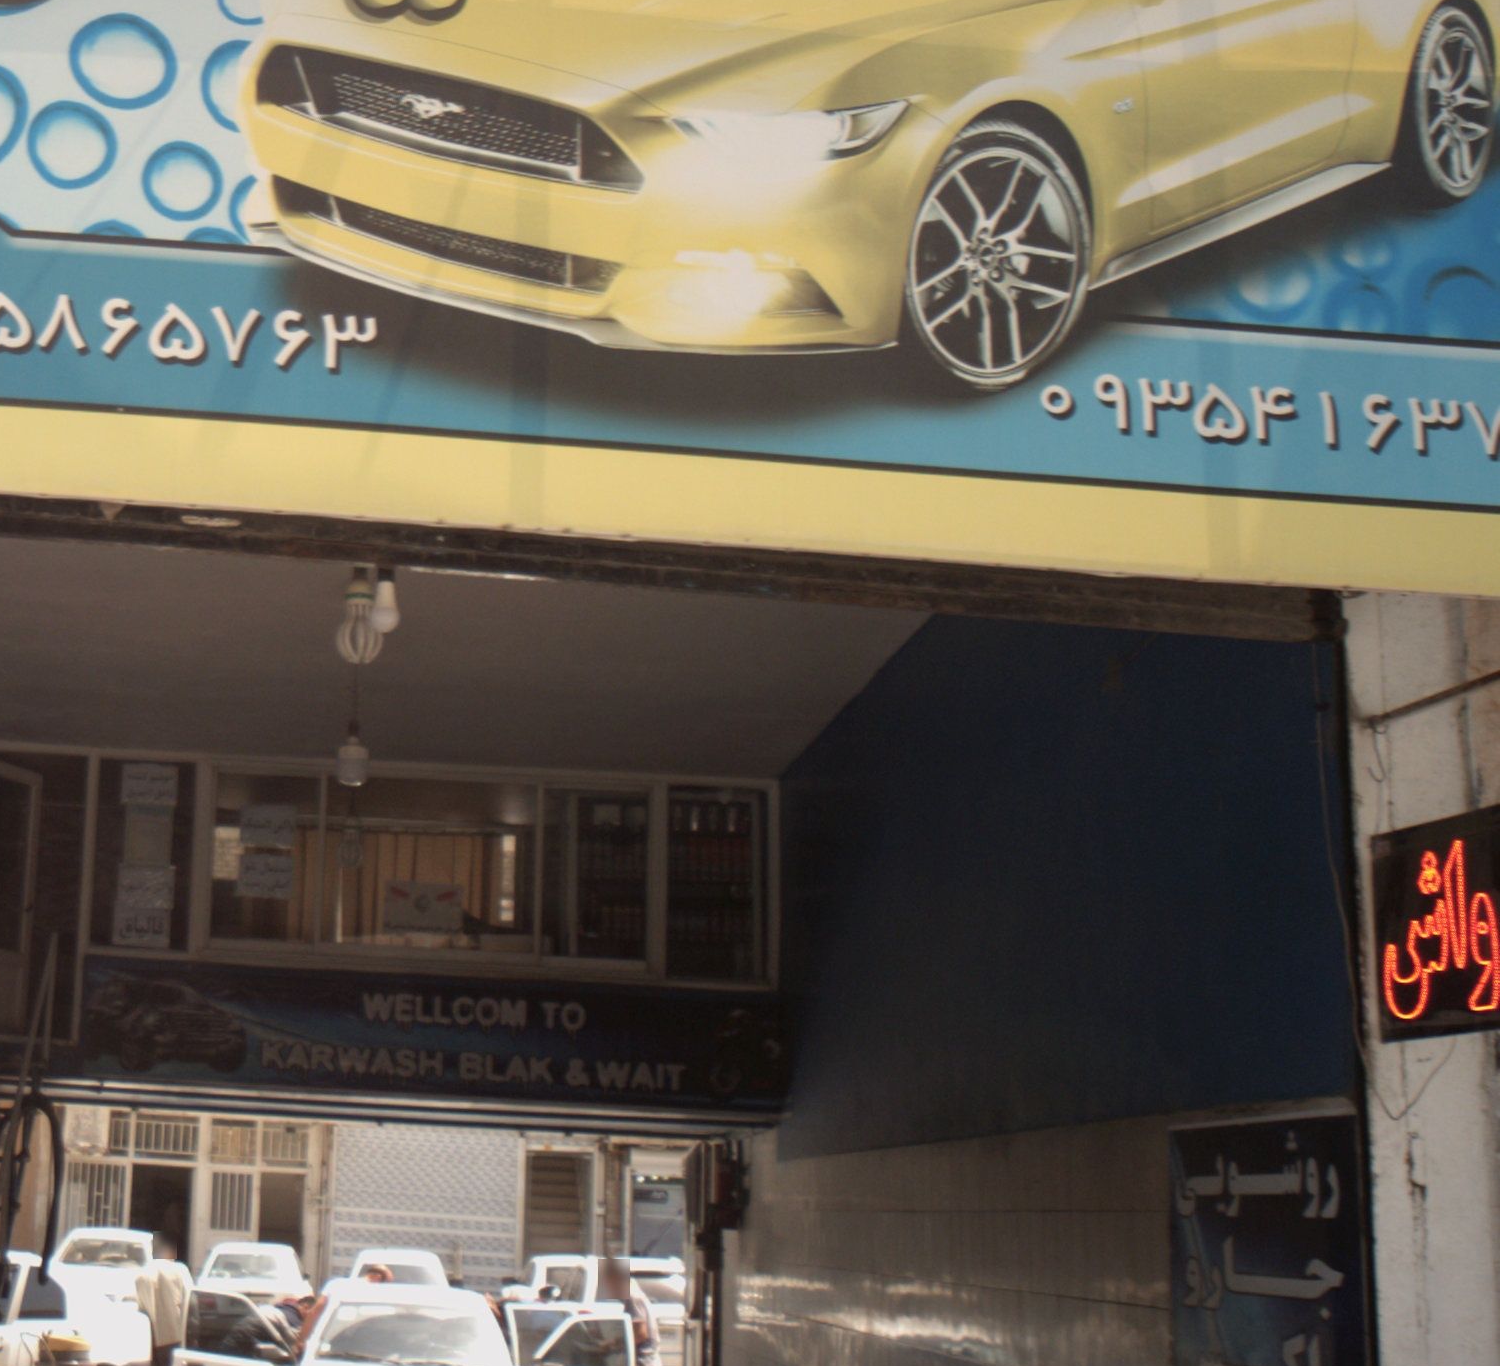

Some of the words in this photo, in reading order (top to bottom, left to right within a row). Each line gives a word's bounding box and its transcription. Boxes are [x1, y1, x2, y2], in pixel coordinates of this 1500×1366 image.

[361, 991, 529, 1031] WELLCOM
[541, 1001, 587, 1032] TO
[260, 1038, 445, 1080] KARWASH
[457, 1050, 553, 1086] BLAK
[565, 1055, 590, 1087] &
[596, 1057, 688, 1092] WAIT
[1184, 1236, 1345, 1320] جارو
